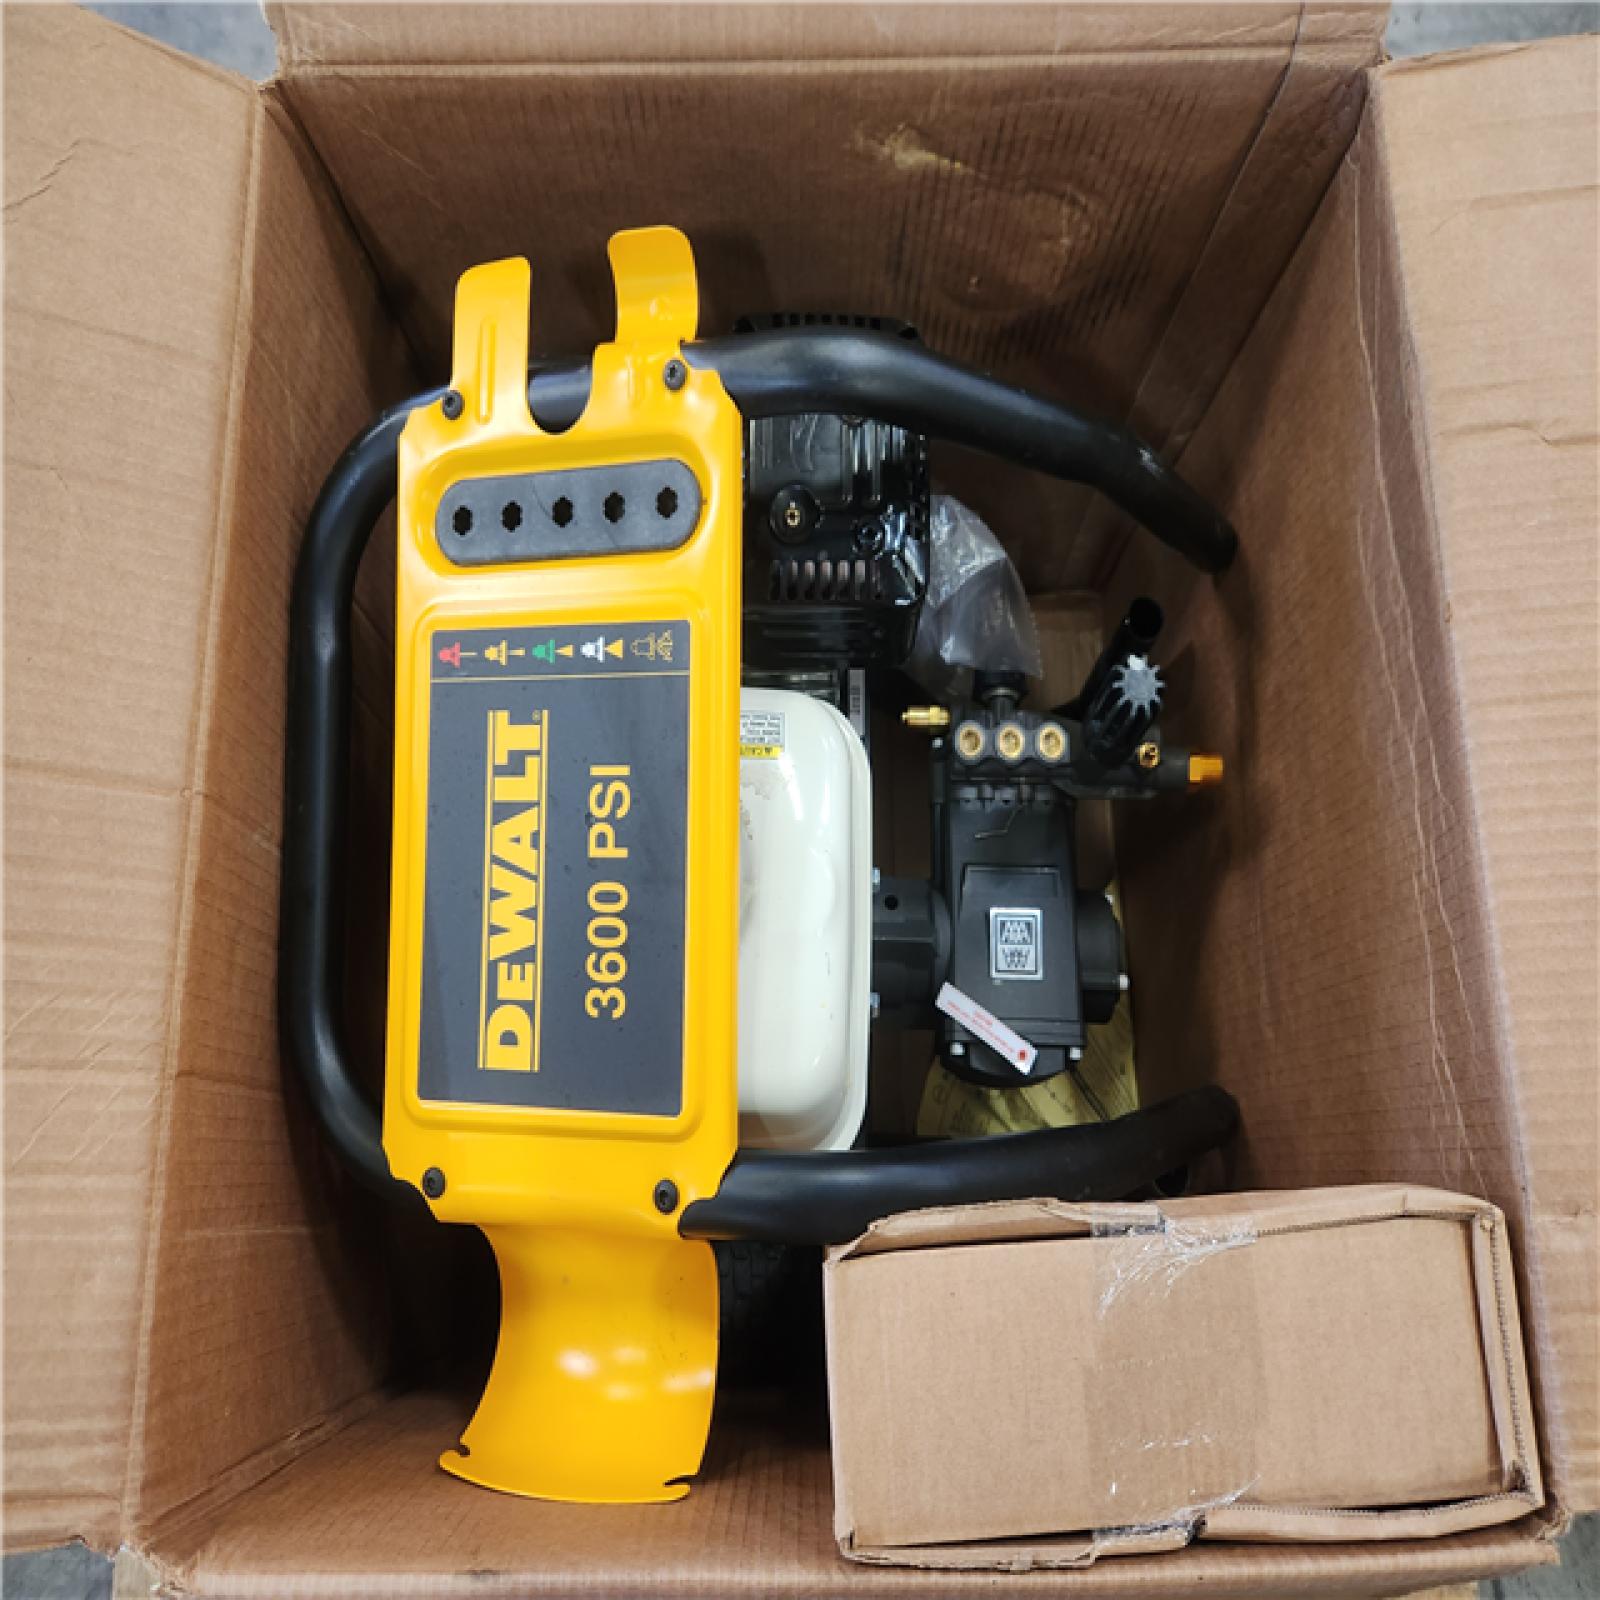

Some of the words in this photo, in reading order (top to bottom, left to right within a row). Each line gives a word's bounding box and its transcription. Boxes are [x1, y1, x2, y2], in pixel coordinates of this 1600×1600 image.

[589, 765, 632, 858] PSI
[482, 711, 545, 1071] DEWALT
[586, 881, 629, 1020] 3600
